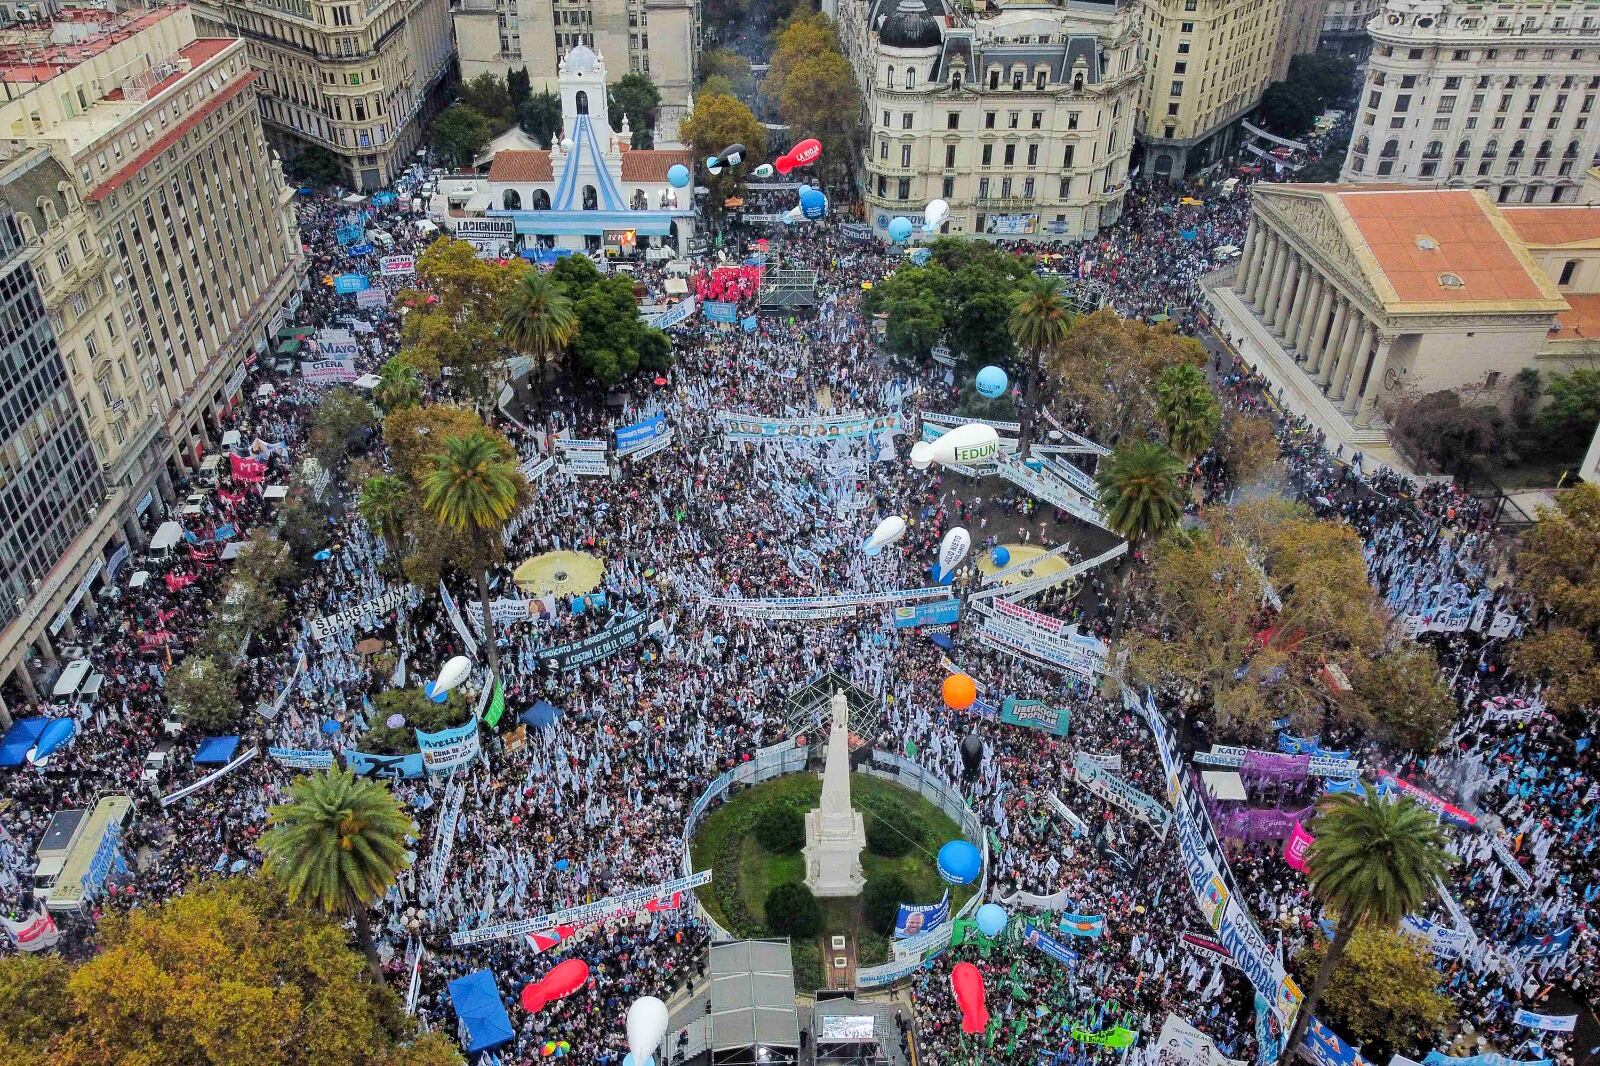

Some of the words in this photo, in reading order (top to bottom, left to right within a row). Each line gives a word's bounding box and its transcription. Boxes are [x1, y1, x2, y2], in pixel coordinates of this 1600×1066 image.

[804, 145, 819, 158] RIOJA
[842, 228, 871, 240] conadu
[319, 342, 356, 353] MAYO
[312, 361, 344, 370] CTERA
[923, 412, 968, 423] CRISTINA
[315, 616, 332, 629] SI
[335, 585, 410, 624] ARGENTINA
[539, 646, 571, 659] SINDICATO
[573, 641, 582, 650] DE
[584, 629, 612, 646] OBREROS
[612, 611, 647, 635] CURTIDORES
[975, 601, 992, 615] JULIO
[993, 612, 1011, 625] NIETO
[1025, 628, 1047, 640] JULIO
[1048, 636, 1068, 648] NIETO
[570, 649, 594, 664] CRISTINA
[595, 645, 602, 657] LE
[620, 631, 636, 646] CUERO
[974, 623, 1031, 650] CRISTINA
[1018, 712, 1057, 726] POPULAR
[1488, 710, 1542, 721] WALSH
[424, 727, 477, 748] AVELLAEDA
[434, 750, 472, 764] RESISTECIA
[1195, 754, 1245, 767] ZABALET
[1218, 747, 1283, 758] KATOODIS
[1100, 769, 1148, 801] PERONISMO
[1406, 784, 1447, 808] FRENTE
[632, 893, 658, 905] EZEIZA
[703, 875, 712, 884] PJ
[900, 904, 934, 912] PRIMERO
[452, 930, 472, 940] DULCE
[474, 926, 505, 937] GRANADOS
[535, 915, 548, 923] CON
[558, 907, 581, 918] GASTON
[581, 899, 612, 913] GRANADOS
[469, 932, 497, 941] EZEIZA
[548, 919, 558, 927] PJ
[578, 908, 604, 919] EZEIZA
[1236, 914, 1274, 973] GABRIEL
[1221, 917, 1278, 1008] KATOPODIS
